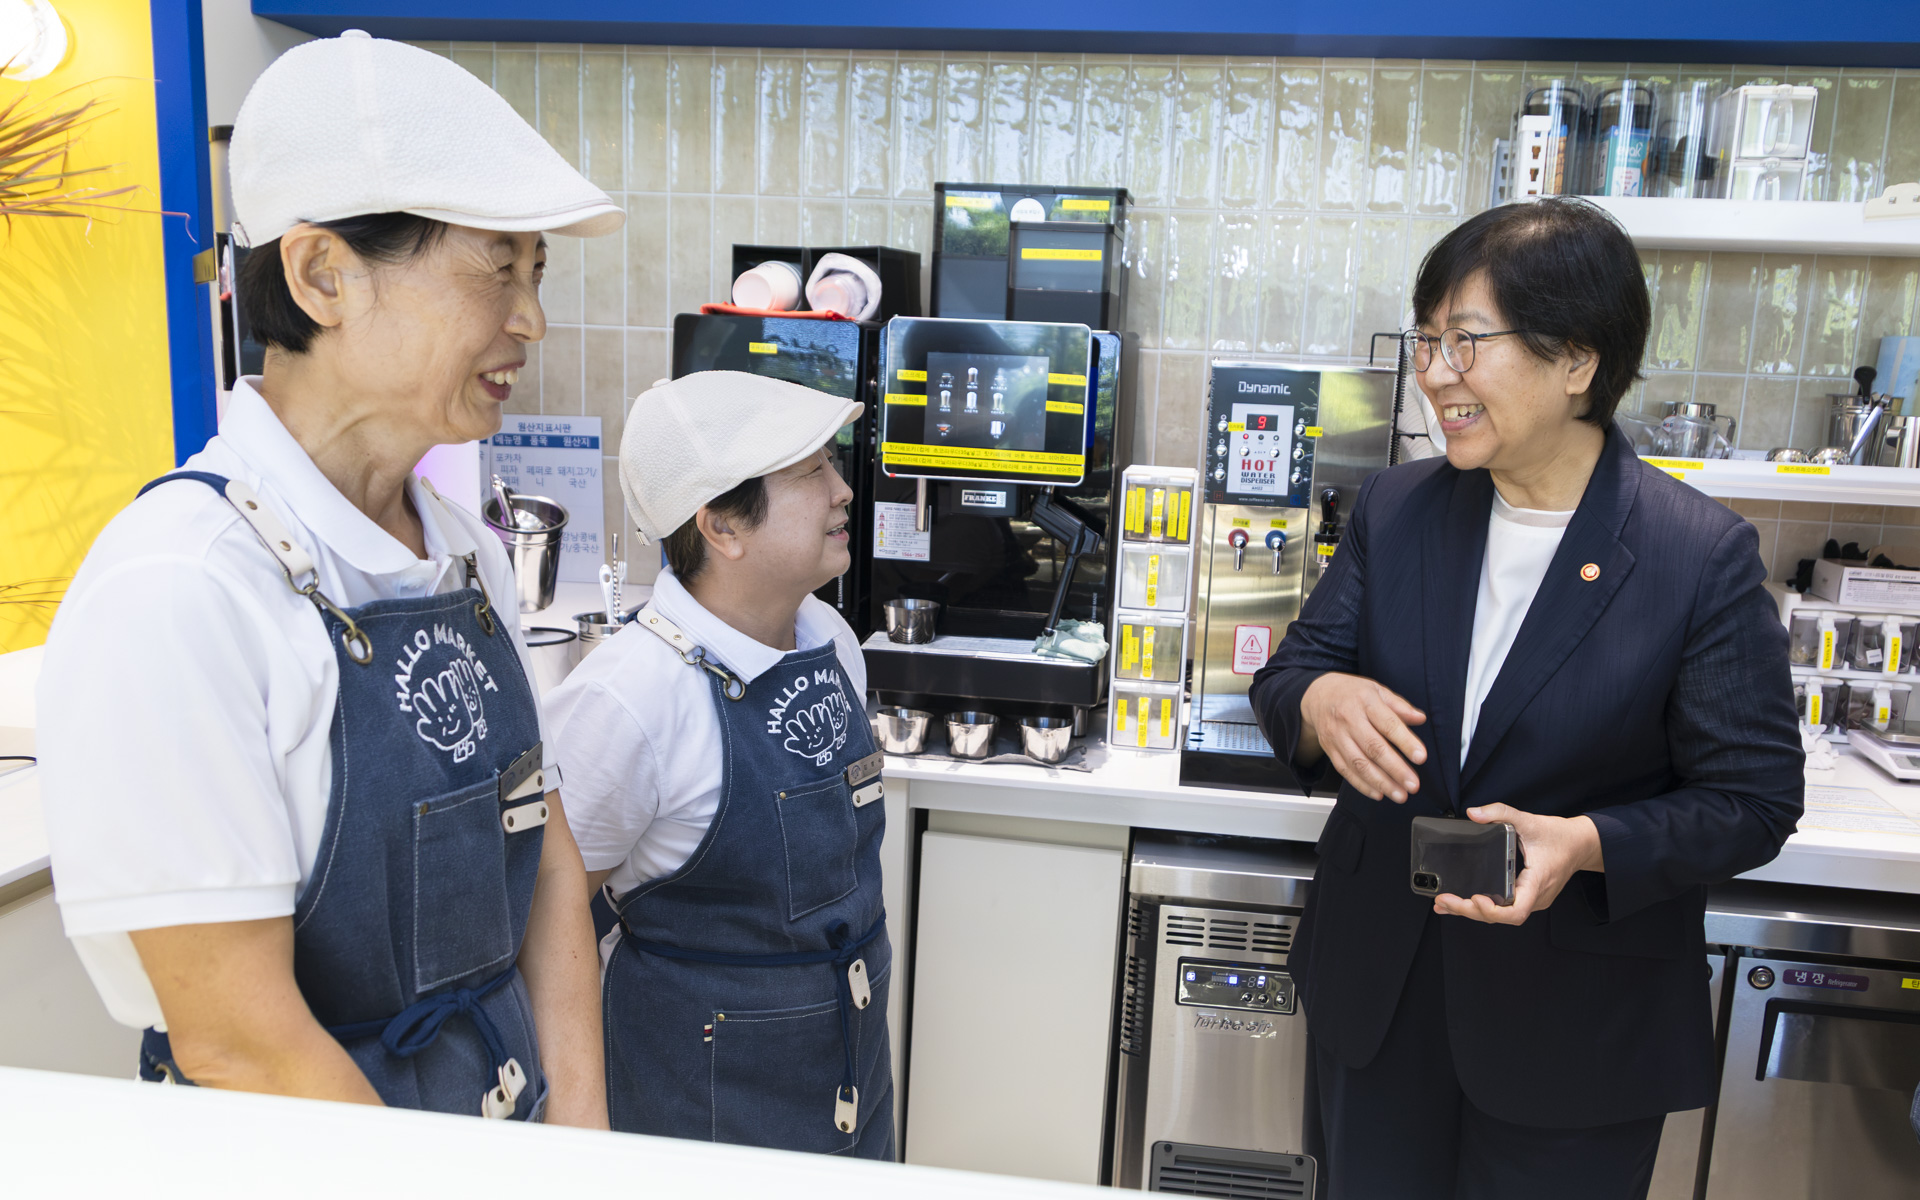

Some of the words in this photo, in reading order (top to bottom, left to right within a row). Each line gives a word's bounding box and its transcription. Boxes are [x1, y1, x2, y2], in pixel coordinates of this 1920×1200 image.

[1238, 381, 1291, 395] Dynamic
[517, 421, 572, 433] 원산지표시판
[1257, 415, 1267, 430] 9
[495, 435, 522, 446] 메뉴명
[529, 436, 548, 446] 품목
[562, 436, 590, 447] 원산지
[500, 464, 518, 474] 피자
[526, 465, 553, 475] 페퍼로
[1241, 459, 1277, 472] HOT
[557, 466, 598, 478] 돼지고기/
[1241, 471, 1276, 479] WATER
[568, 478, 587, 488] 국산
[964, 494, 997, 503] FRANKE
[395, 629, 431, 713] HALLO
[434, 623, 499, 693] MARKET
[766, 676, 809, 734] HALLO
[1827, 979, 1858, 988] Refrigerator
